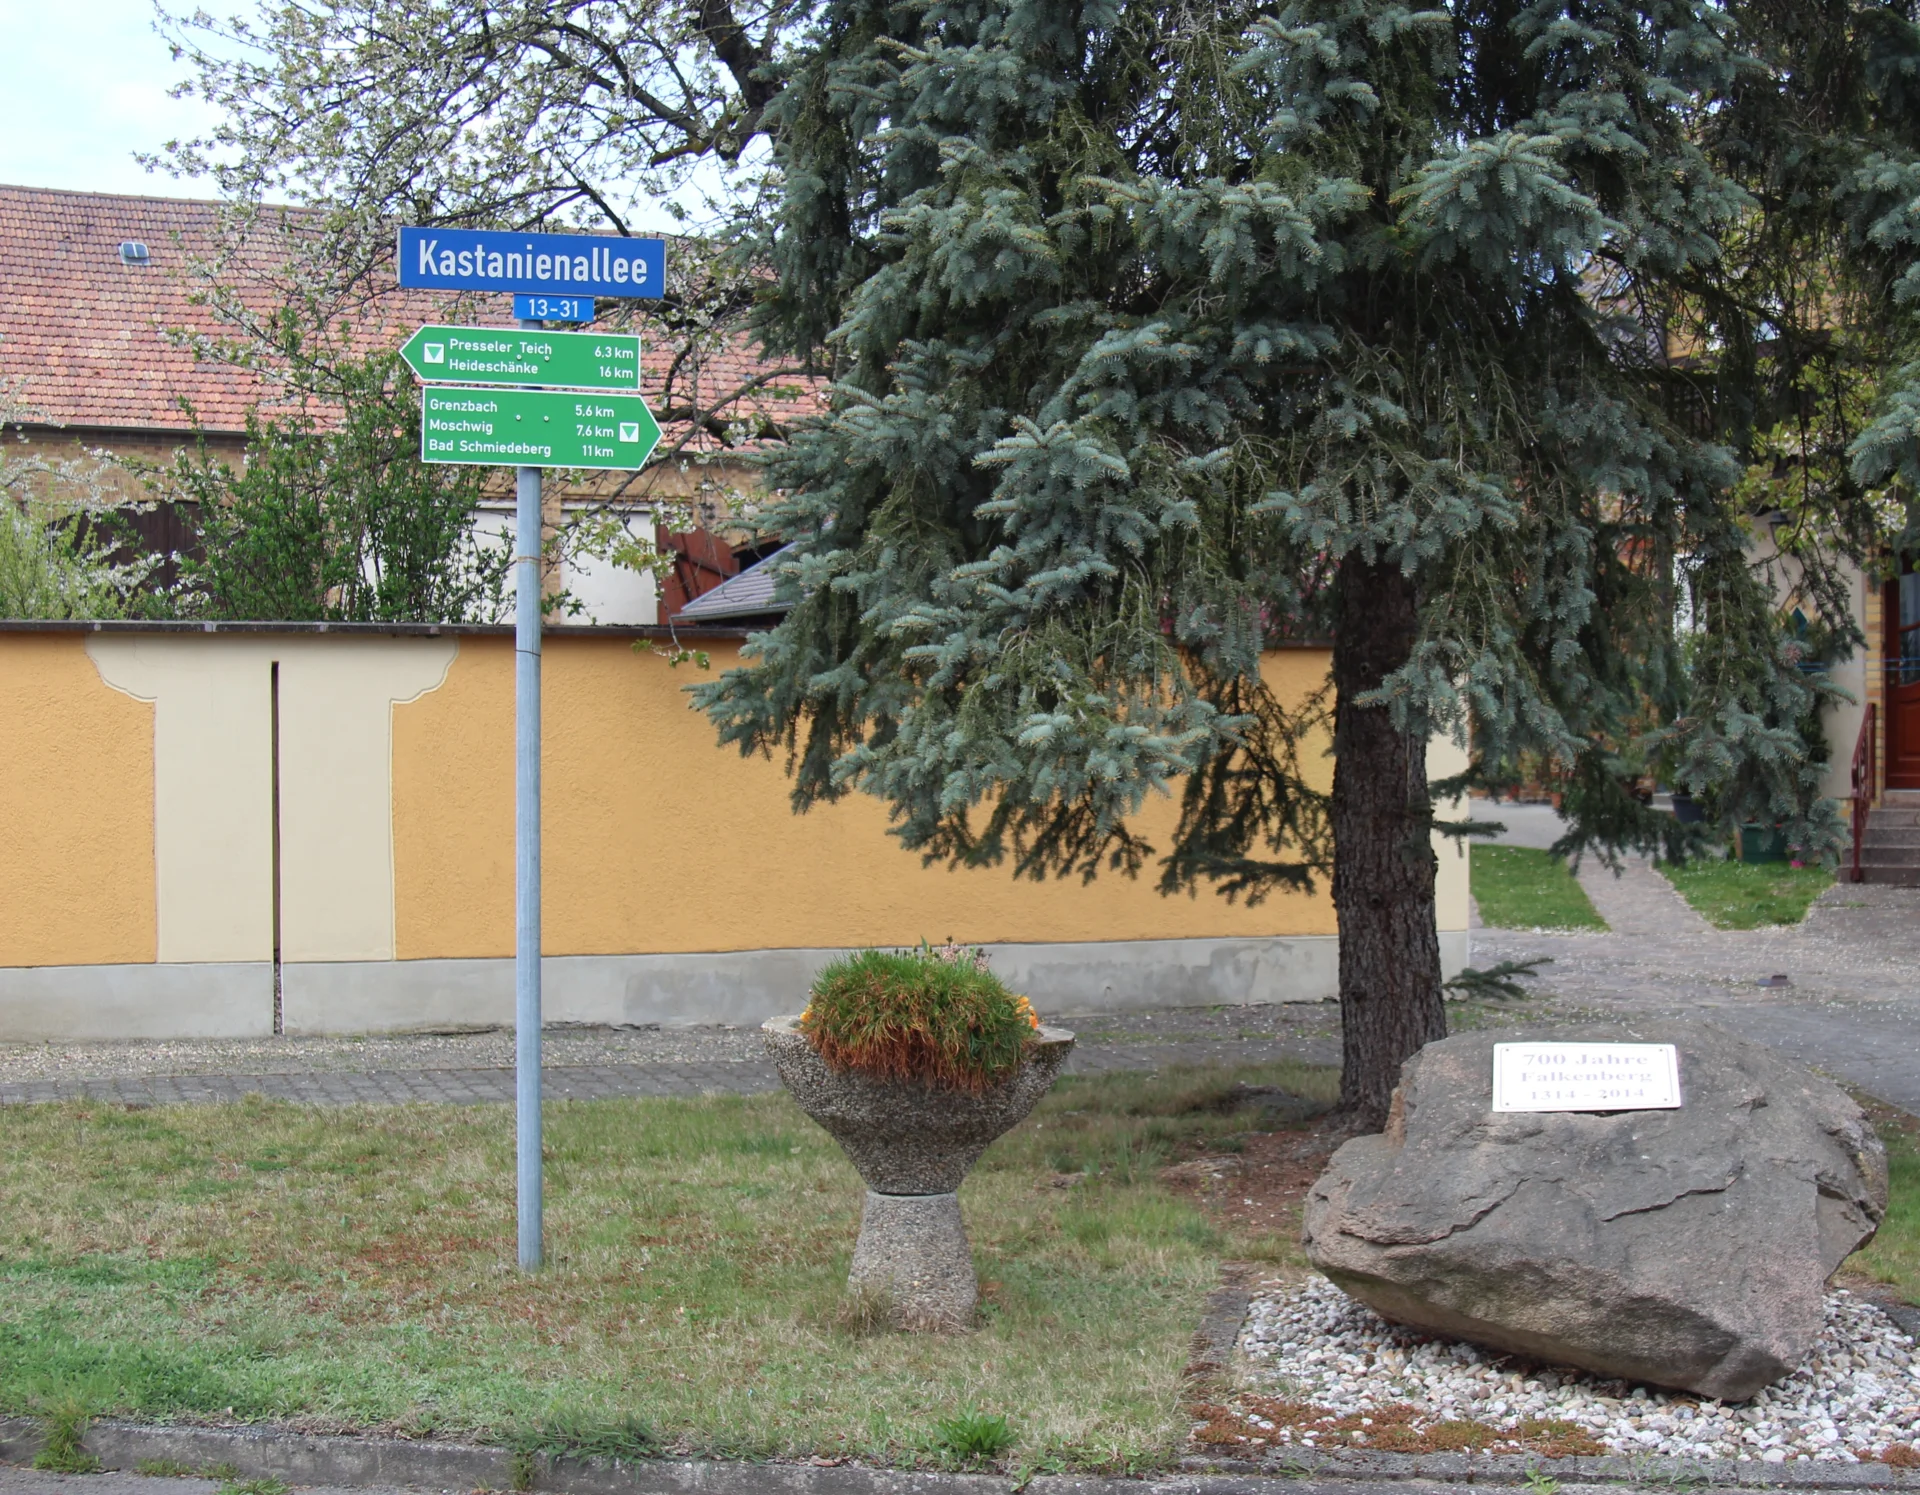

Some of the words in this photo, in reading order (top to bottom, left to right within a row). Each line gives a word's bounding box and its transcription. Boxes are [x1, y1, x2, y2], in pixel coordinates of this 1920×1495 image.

[419, 239, 647, 284] Kastanienallee
[528, 299, 578, 318] 13-31
[449, 339, 512, 353] Presseler
[520, 342, 552, 355] Teich
[614, 347, 634, 359] km
[449, 359, 538, 374] Heideschänke
[600, 366, 611, 378] 16
[614, 367, 633, 379] km
[430, 399, 497, 413] Grenzbach
[595, 406, 614, 417] km
[430, 419, 493, 435] Moschwig
[595, 426, 614, 437] km
[429, 440, 453, 451] Bad
[460, 441, 551, 457] Schmiedeberg
[582, 445, 592, 456] 11
[594, 445, 614, 457] km
[1523, 1054, 1566, 1065] 700
[1575, 1054, 1648, 1065] Jahre
[1521, 1072, 1653, 1082] Falkenberg
[1532, 1090, 1575, 1100] 1314
[1598, 1089, 1644, 1098] 2014
